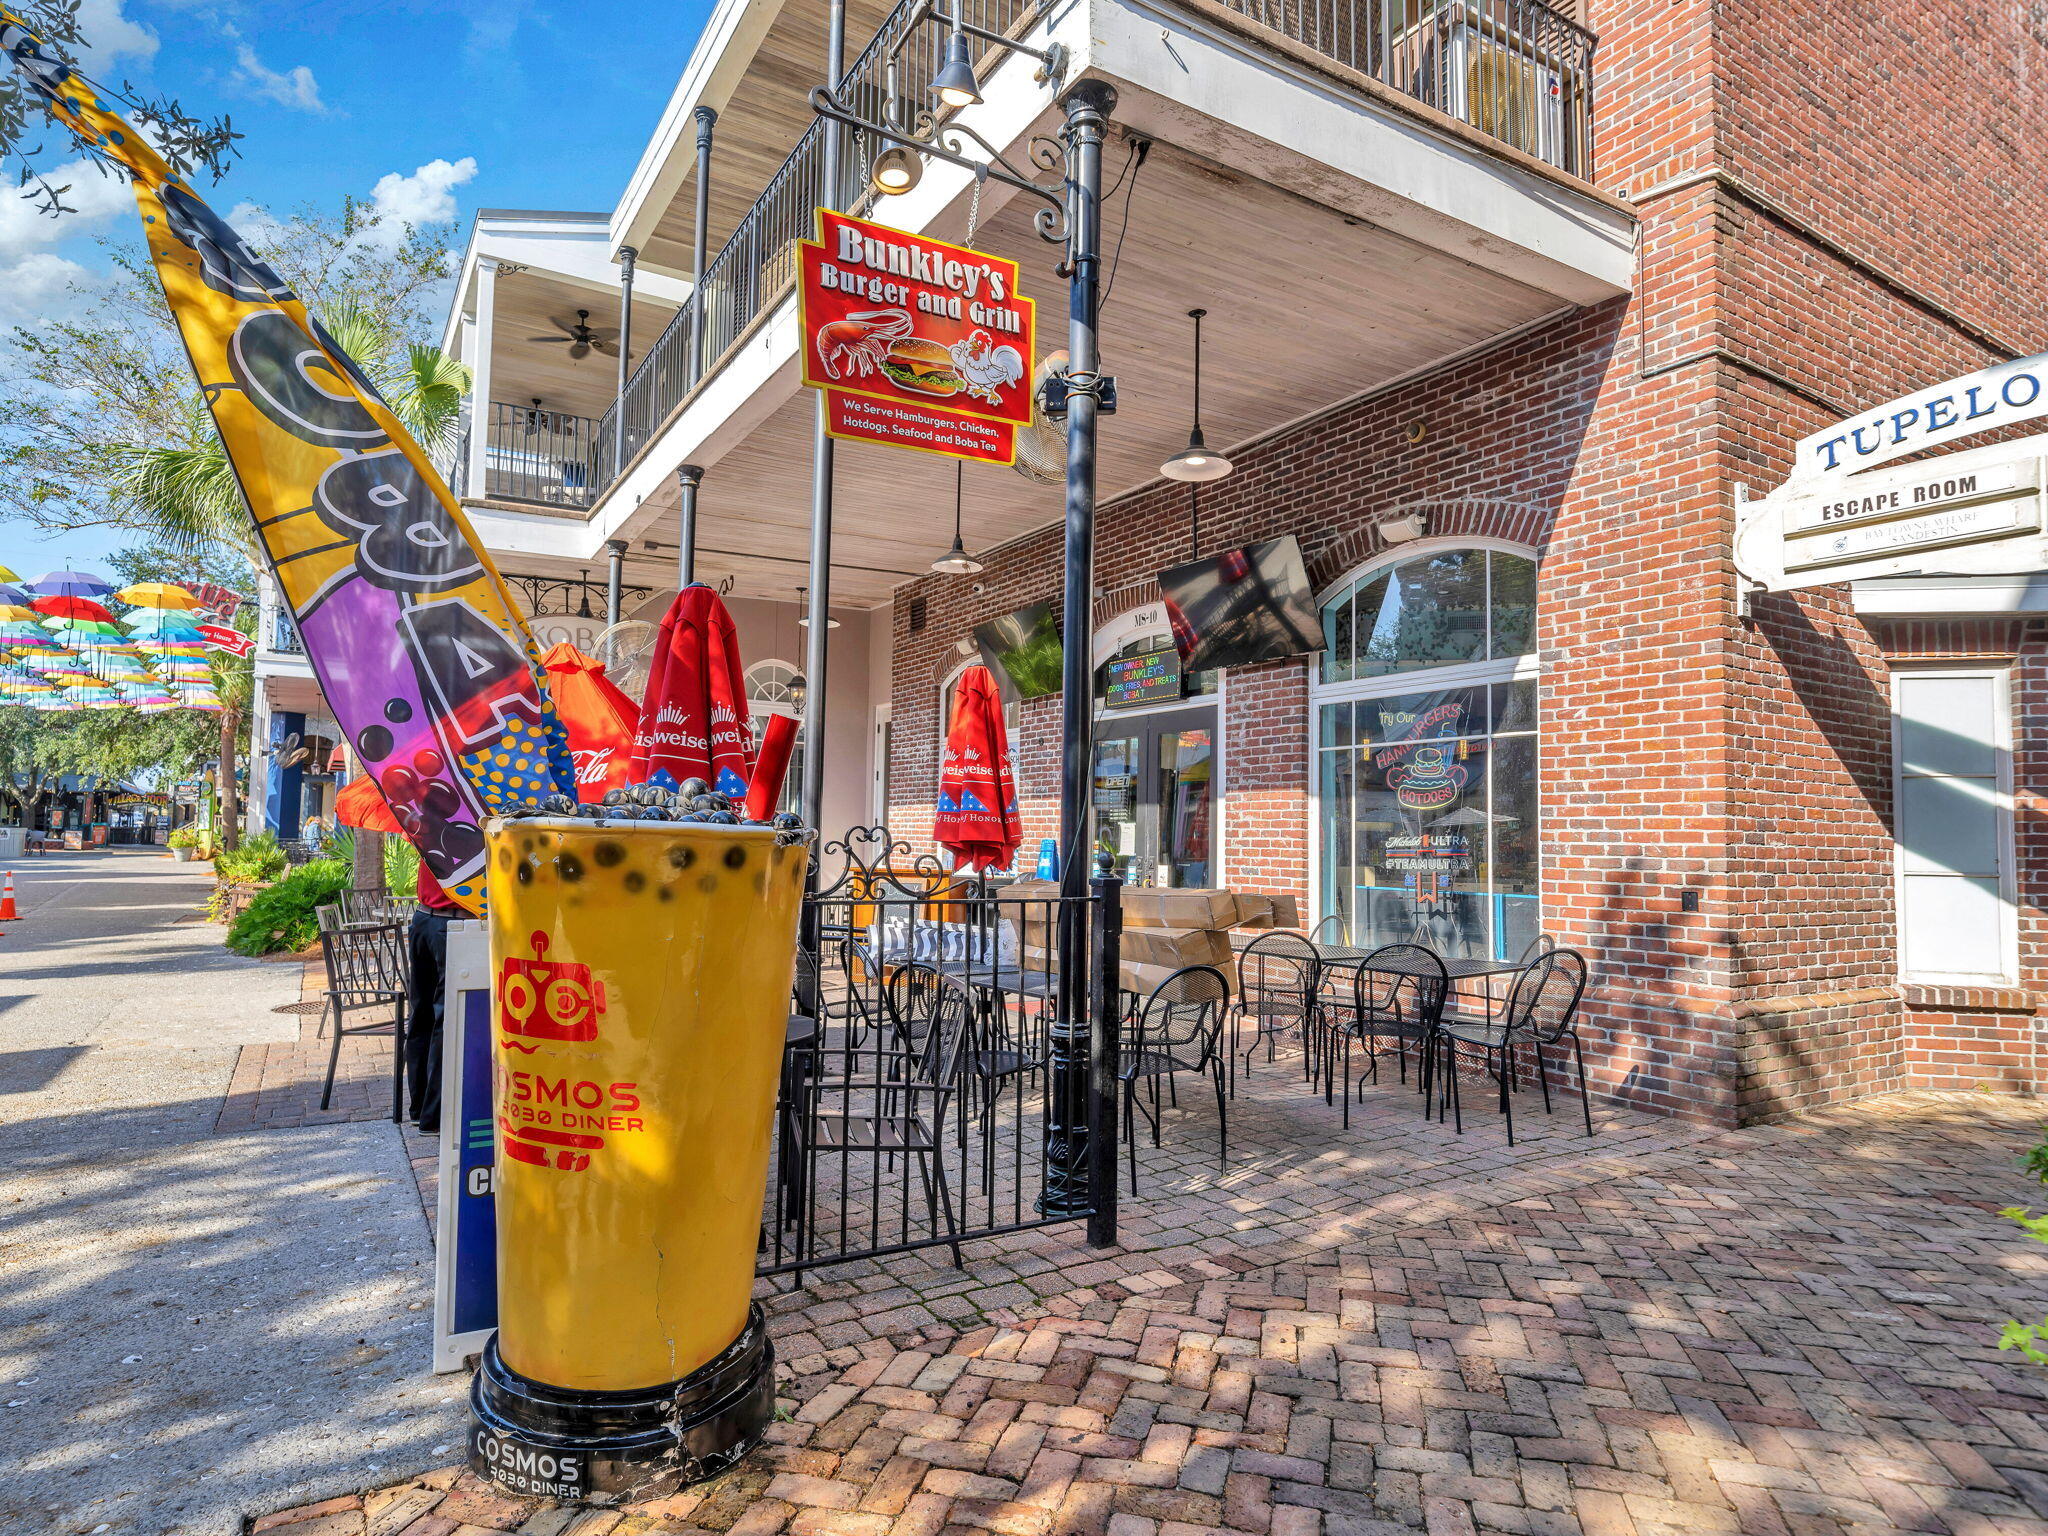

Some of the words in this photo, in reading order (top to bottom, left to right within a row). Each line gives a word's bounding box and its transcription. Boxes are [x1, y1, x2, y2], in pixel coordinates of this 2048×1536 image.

[837, 224, 1004, 301] Bunkley's
[820, 262, 910, 307] Burger
[917, 290, 962, 321] and
[969, 303, 1021, 334] Grill
[842, 398, 861, 412] We
[863, 402, 894, 418] Serve
[895, 408, 958, 430] Hamburgers,
[959, 421, 999, 438] Chicken,
[1816, 373, 2041, 472] TUPELO
[843, 414, 890, 434] Hotdogs,
[892, 424, 933, 441] Seafood
[935, 433, 953, 444] and
[955, 435, 979, 449] Boba
[980, 440, 996, 451] Tea
[1822, 491, 1899, 521] ESCAPE
[1914, 475, 1977, 504] ROOM
[1934, 512, 1977, 527] WHARF
[1892, 525, 1958, 543] SANDESTIN
[1134, 609, 1158, 627] MS-10
[213, 632, 232, 643] House
[530, 624, 594, 651] KOB
[1111, 663, 1124, 673] NEW
[1146, 656, 1160, 666] NEW
[1123, 665, 1165, 682] BUNKLEY'S
[1142, 678, 1155, 687] AND
[1155, 674, 1177, 686] TREATS
[1379, 712, 1394, 726] Try
[1396, 712, 1416, 723] Our
[1375, 703, 1462, 769] HAMBURGERS
[1106, 775, 1129, 787] OPEN
[1401, 787, 1452, 804] HOTDOGS
[1430, 835, 1468, 846] ULTRA
[496, 1060, 640, 1112] OSMOS
[562, 1113, 644, 1132] DINER
[477, 1430, 579, 1482] COSMOS
[531, 1480, 581, 1499] DINER
